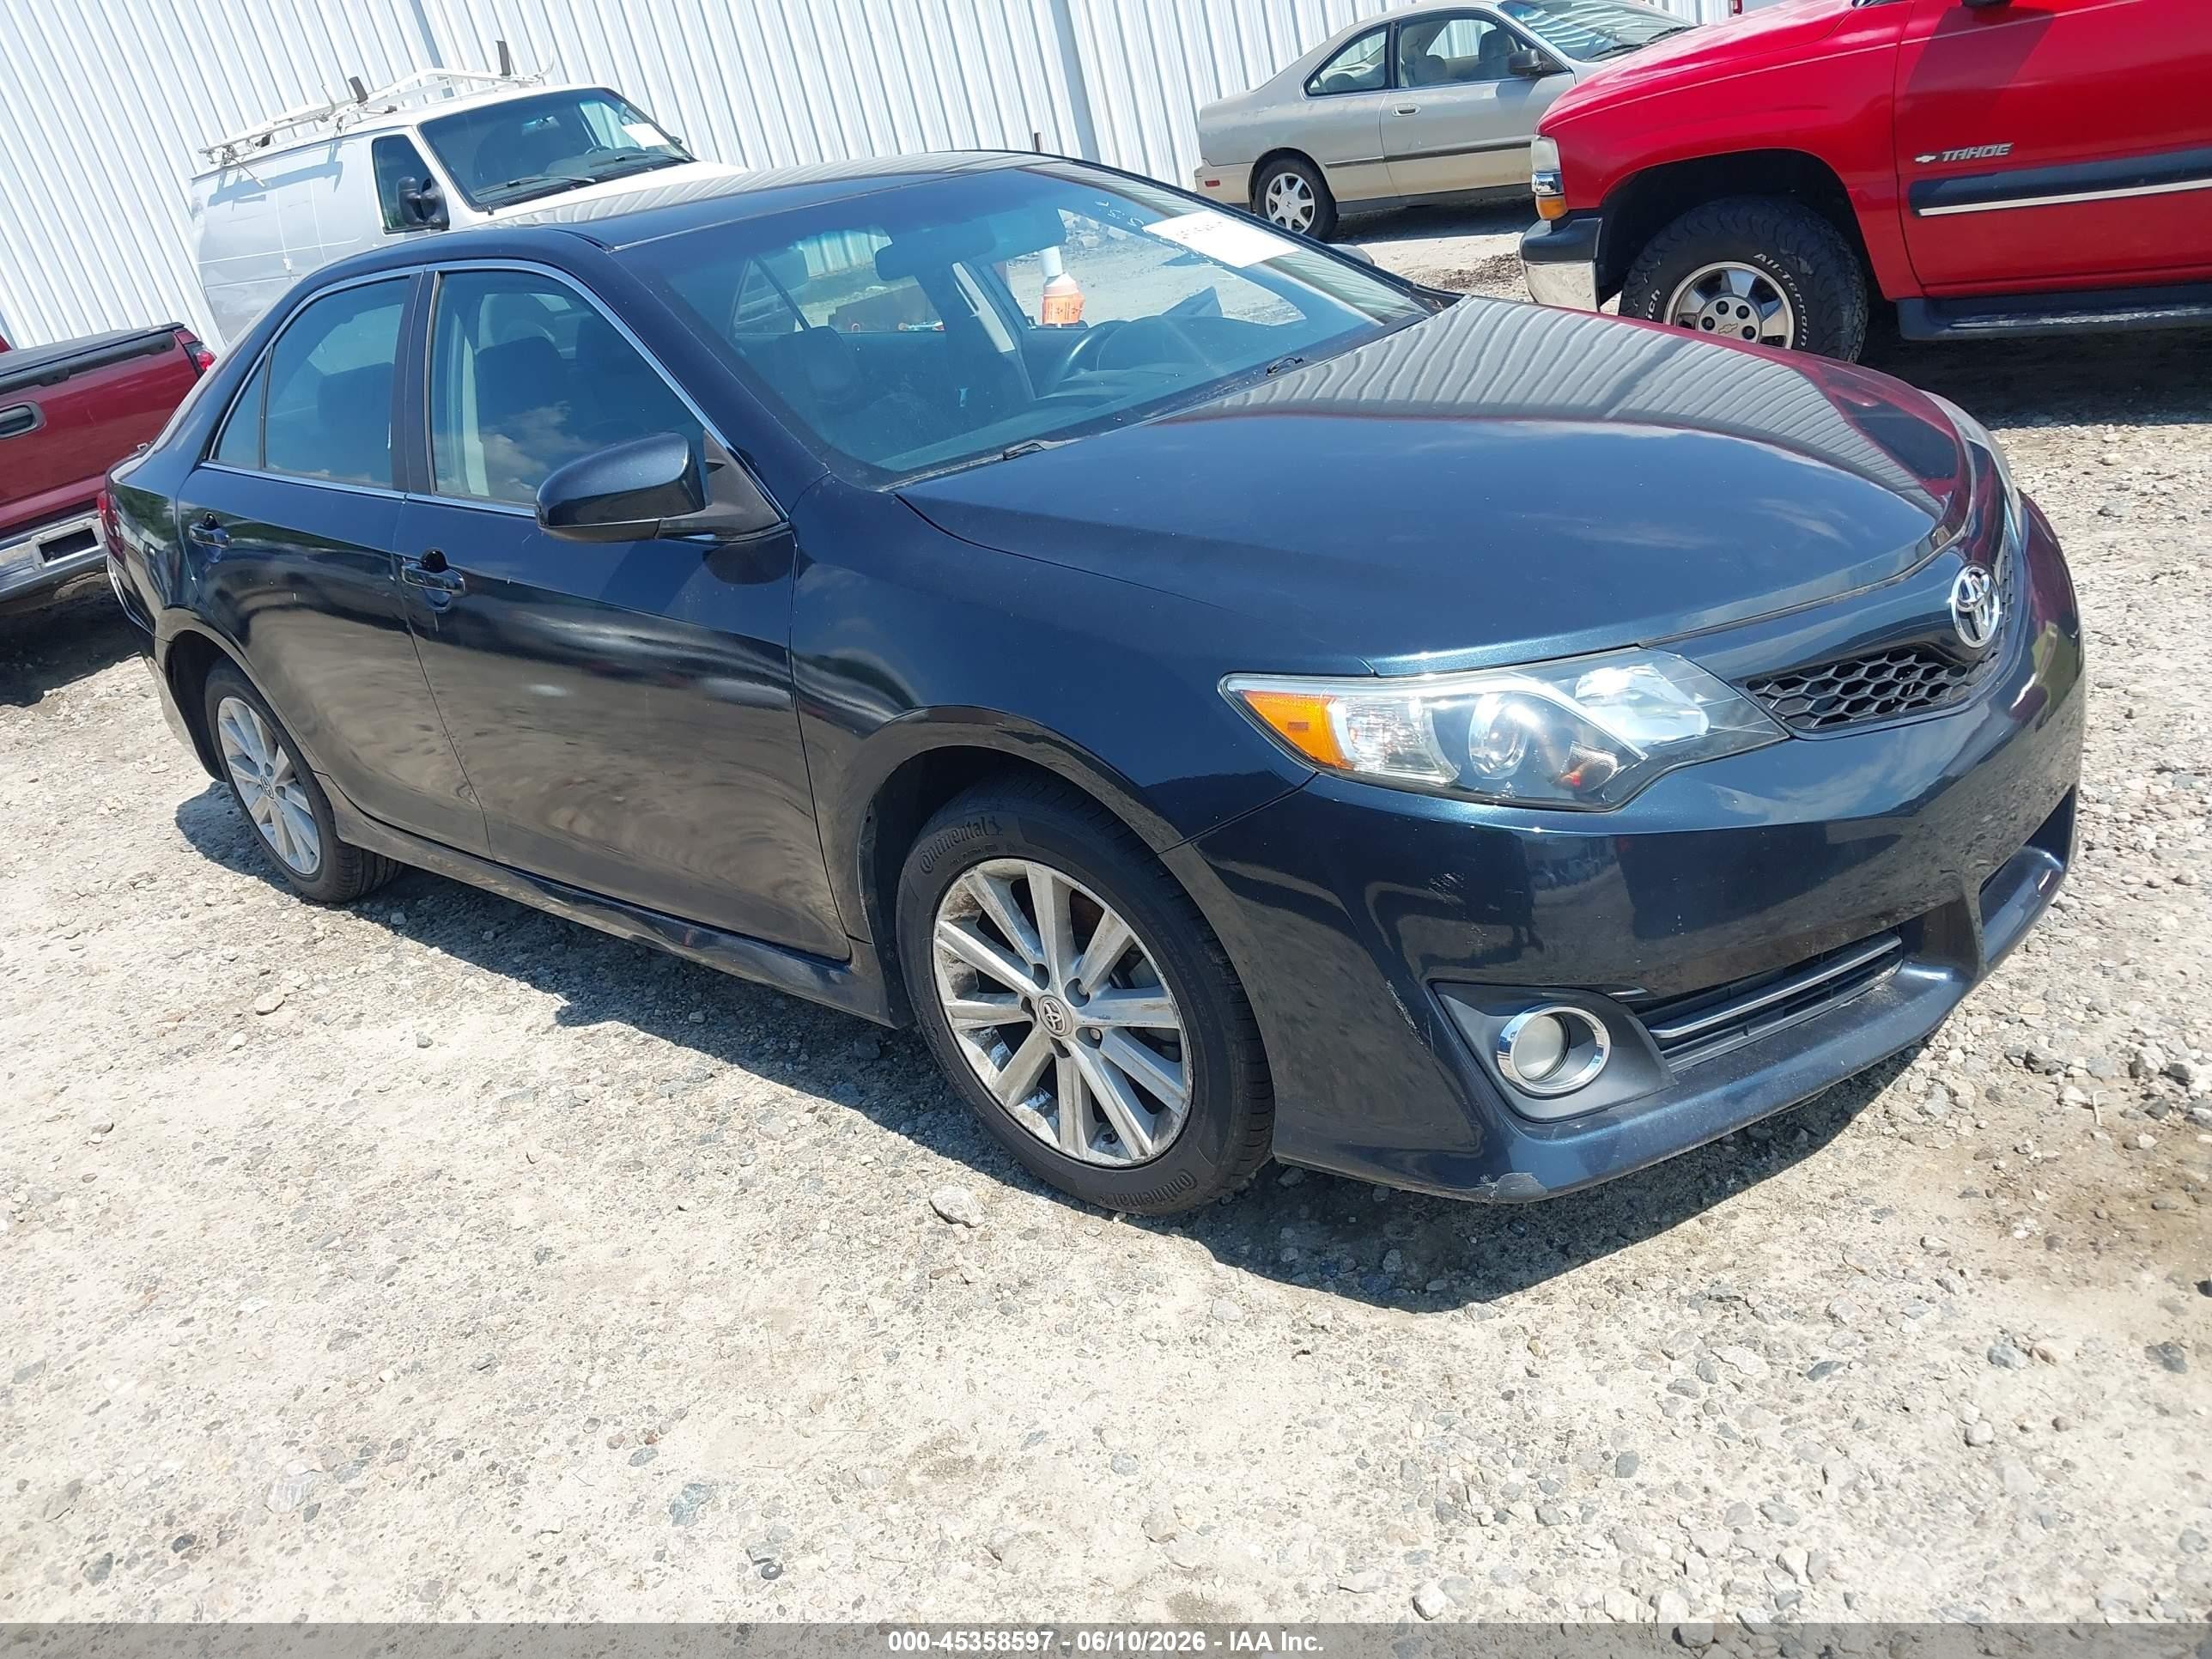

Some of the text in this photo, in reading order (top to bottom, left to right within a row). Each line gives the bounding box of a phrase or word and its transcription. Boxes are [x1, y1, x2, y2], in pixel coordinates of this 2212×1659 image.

[1942, 142, 2014, 162] TAHOE
[1753, 253, 1810, 347] All-Terrain
[920, 816, 989, 874] Continental
